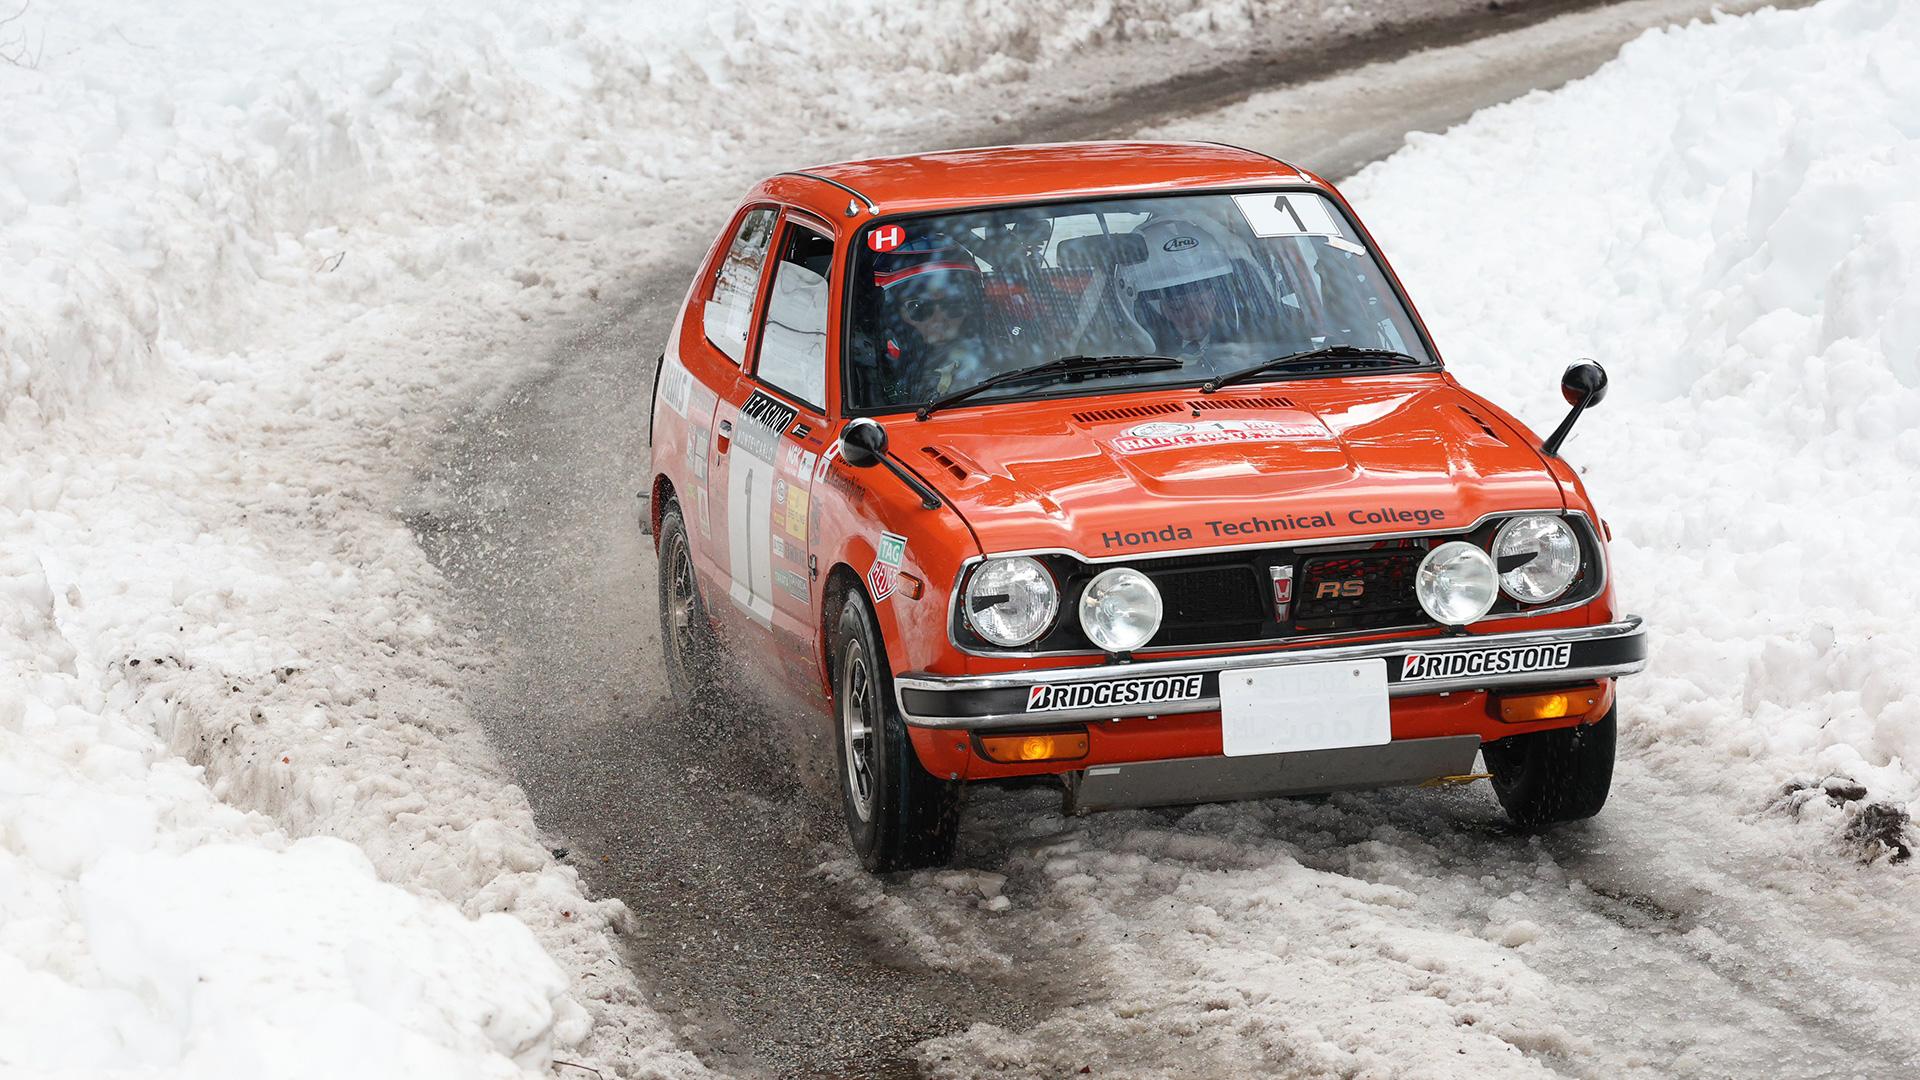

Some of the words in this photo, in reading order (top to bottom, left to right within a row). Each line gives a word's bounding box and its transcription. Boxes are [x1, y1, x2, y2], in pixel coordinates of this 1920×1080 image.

[1274, 196, 1307, 232] 1
[875, 227, 898, 250] H
[1167, 238, 1196, 249] Arai
[750, 400, 793, 438] CASINO
[1121, 436, 1187, 450] RALLYE
[745, 468, 754, 607] 1
[1102, 525, 1193, 548] Honda
[1205, 511, 1336, 537] Technical
[1348, 508, 1445, 525] College
[882, 540, 900, 562] TAG
[872, 563, 897, 593] HEUER
[1316, 580, 1364, 599] RS
[1404, 646, 1568, 679] BRIDGESTONE
[1030, 677, 1200, 710] BRIDGESTONE
